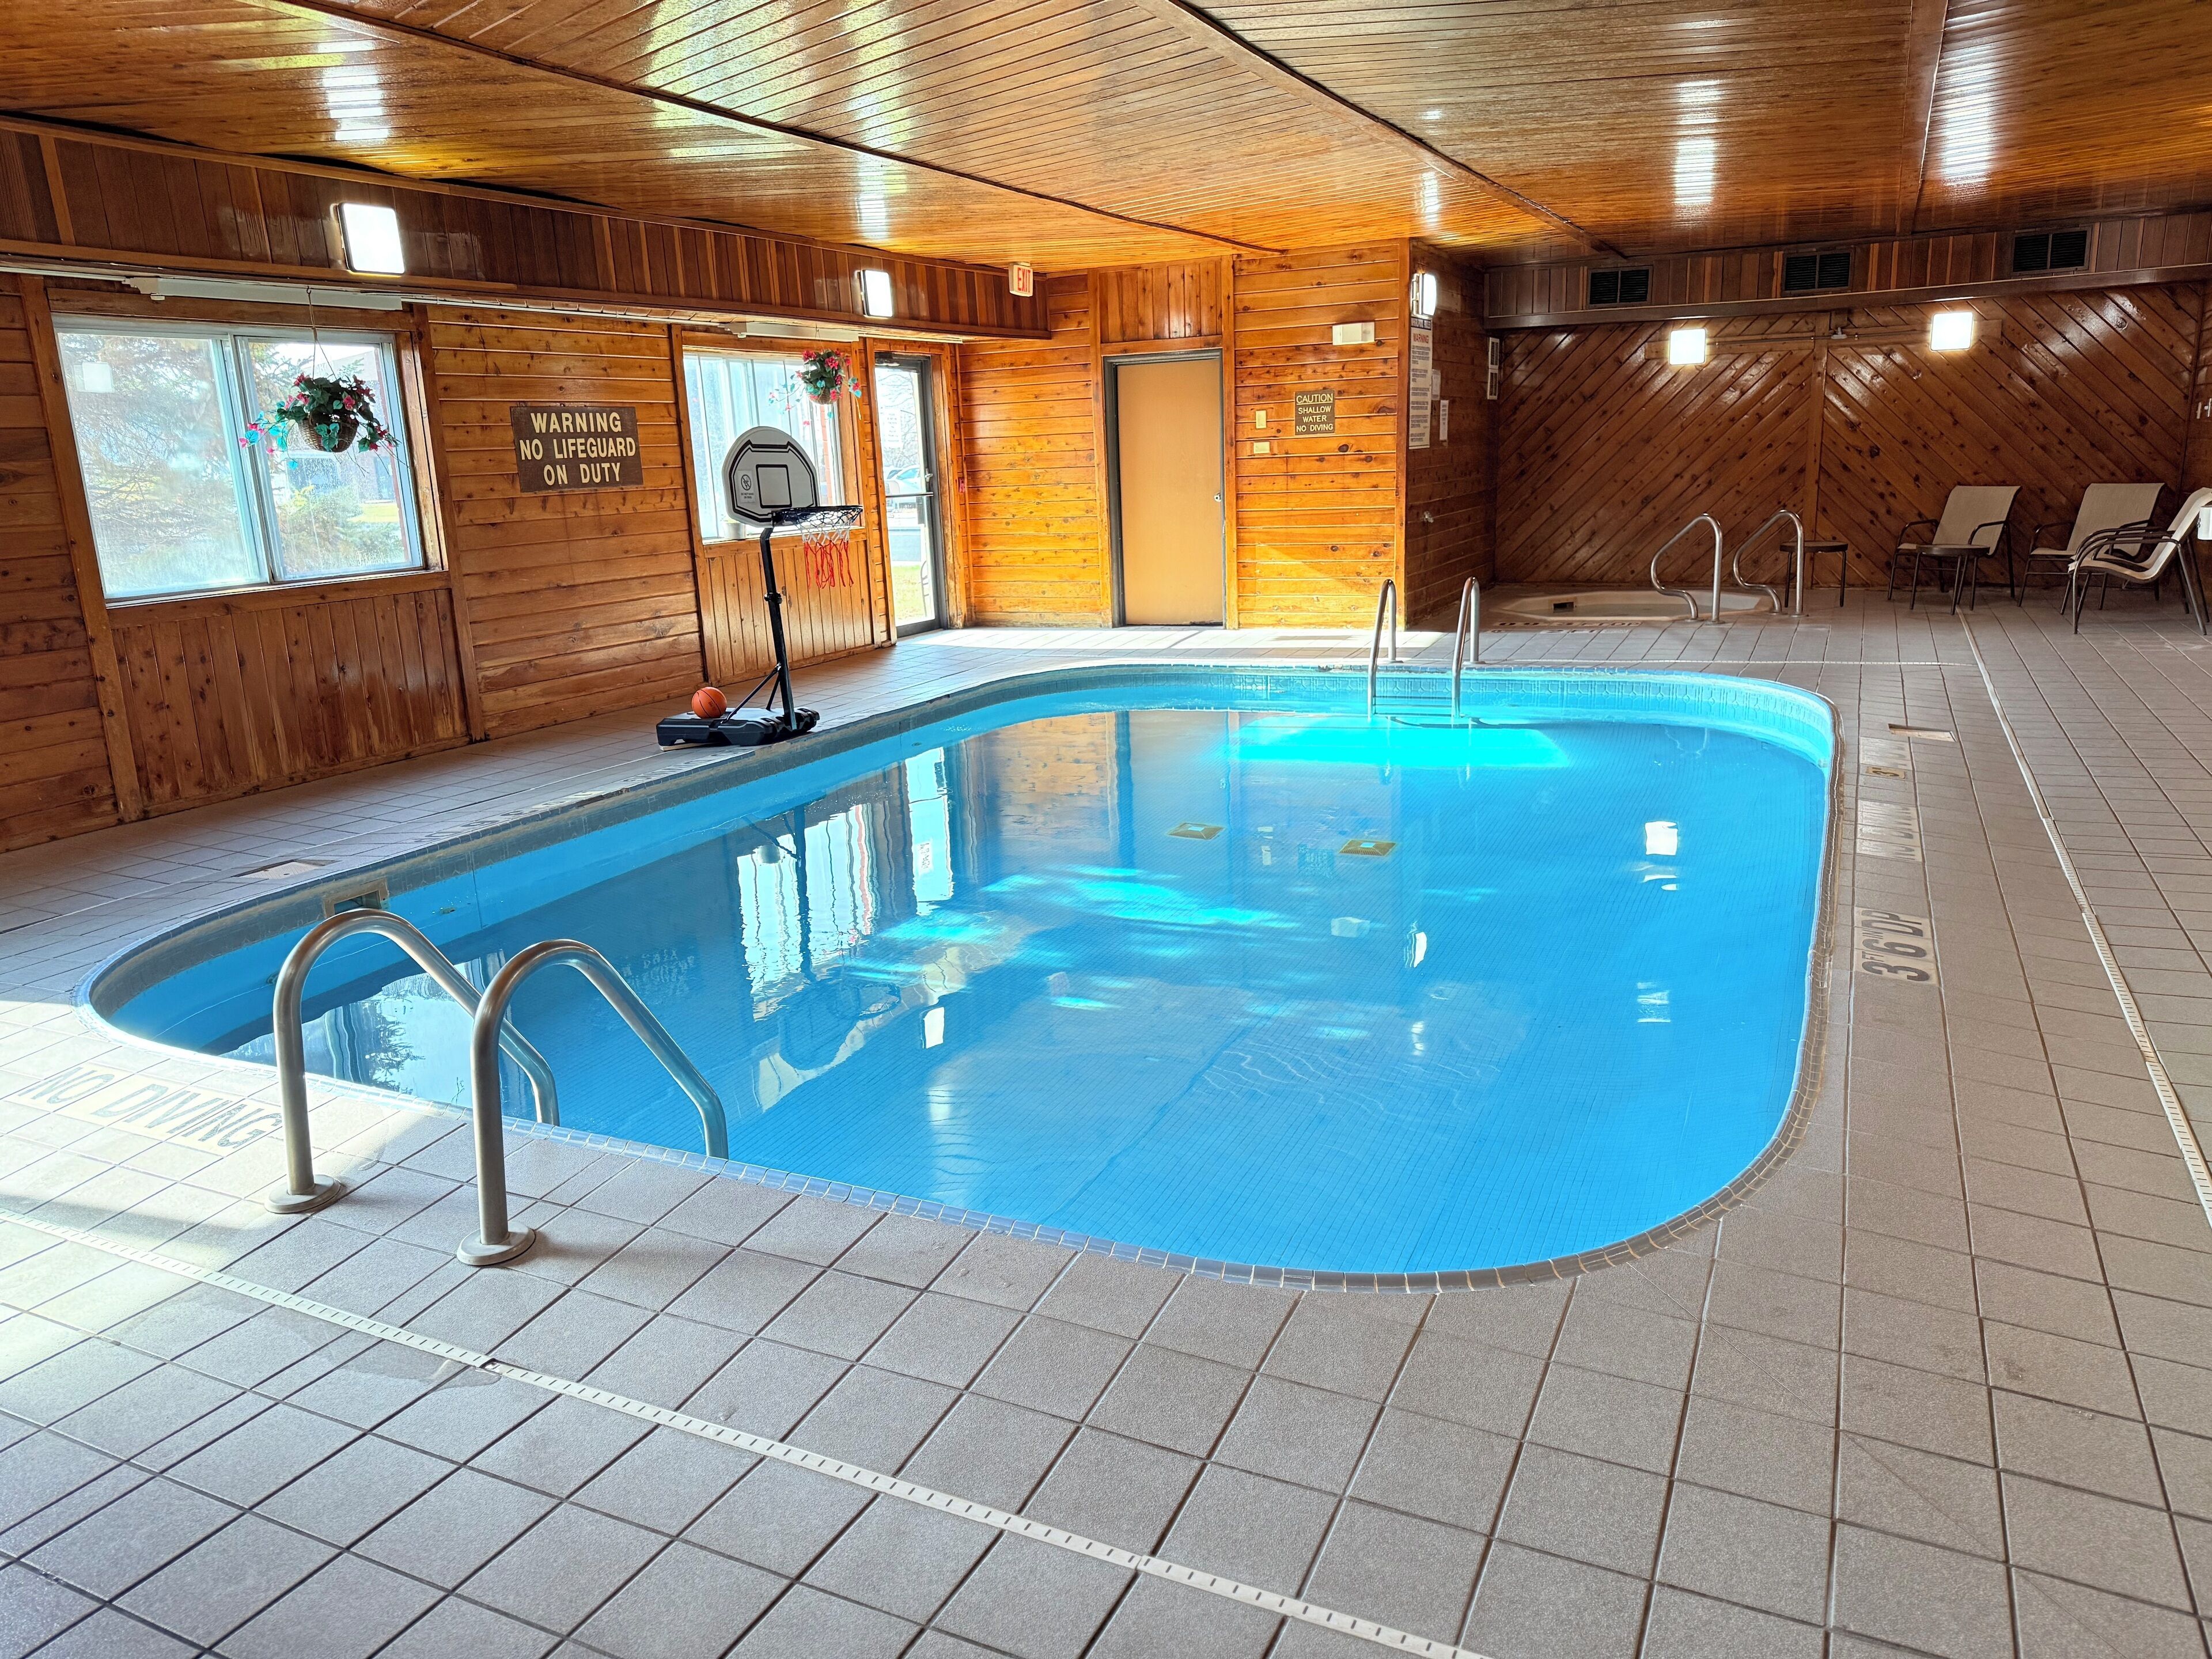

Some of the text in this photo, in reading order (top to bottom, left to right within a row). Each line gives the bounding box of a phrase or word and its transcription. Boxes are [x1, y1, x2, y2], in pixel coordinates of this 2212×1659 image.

[1017, 267, 1031, 293] EXIT
[1296, 393, 1333, 403] CAUTION
[1298, 406, 1331, 414] SHALLOW
[531, 412, 622, 433] WARNING
[520, 437, 636, 460] NO LIFEGUARD
[543, 463, 620, 486] ON DUTY
[1861, 910, 1923, 937] DP
[18, 1067, 282, 1149] NO DIVING
